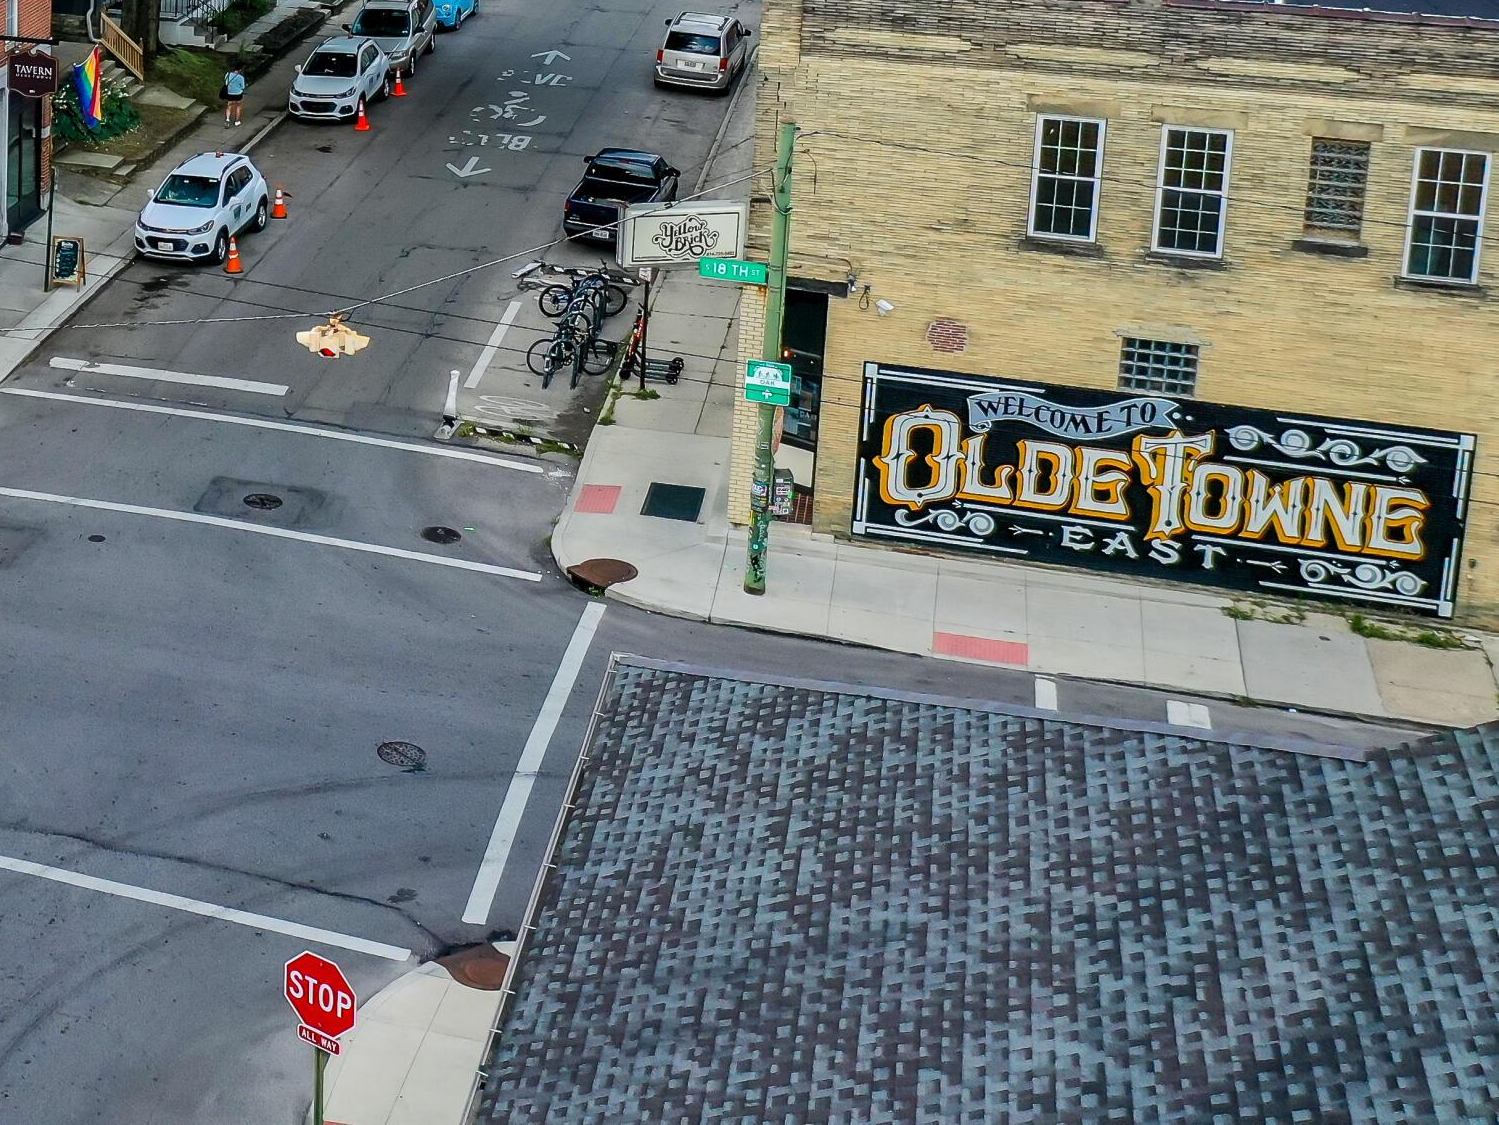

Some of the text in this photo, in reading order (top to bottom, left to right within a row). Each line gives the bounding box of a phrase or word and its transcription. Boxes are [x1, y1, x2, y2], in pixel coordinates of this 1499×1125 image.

[14, 64, 53, 76] TAVERN
[655, 217, 706, 249] Yellow
[713, 262, 727, 275] 18
[731, 264, 749, 277] TH
[975, 396, 1157, 435] WELCOME TO
[873, 403, 1430, 561] OLDE TOWNE
[1060, 524, 1226, 569] EAST
[289, 970, 352, 1019] STOP
[301, 1029, 337, 1052] ALL WAY
